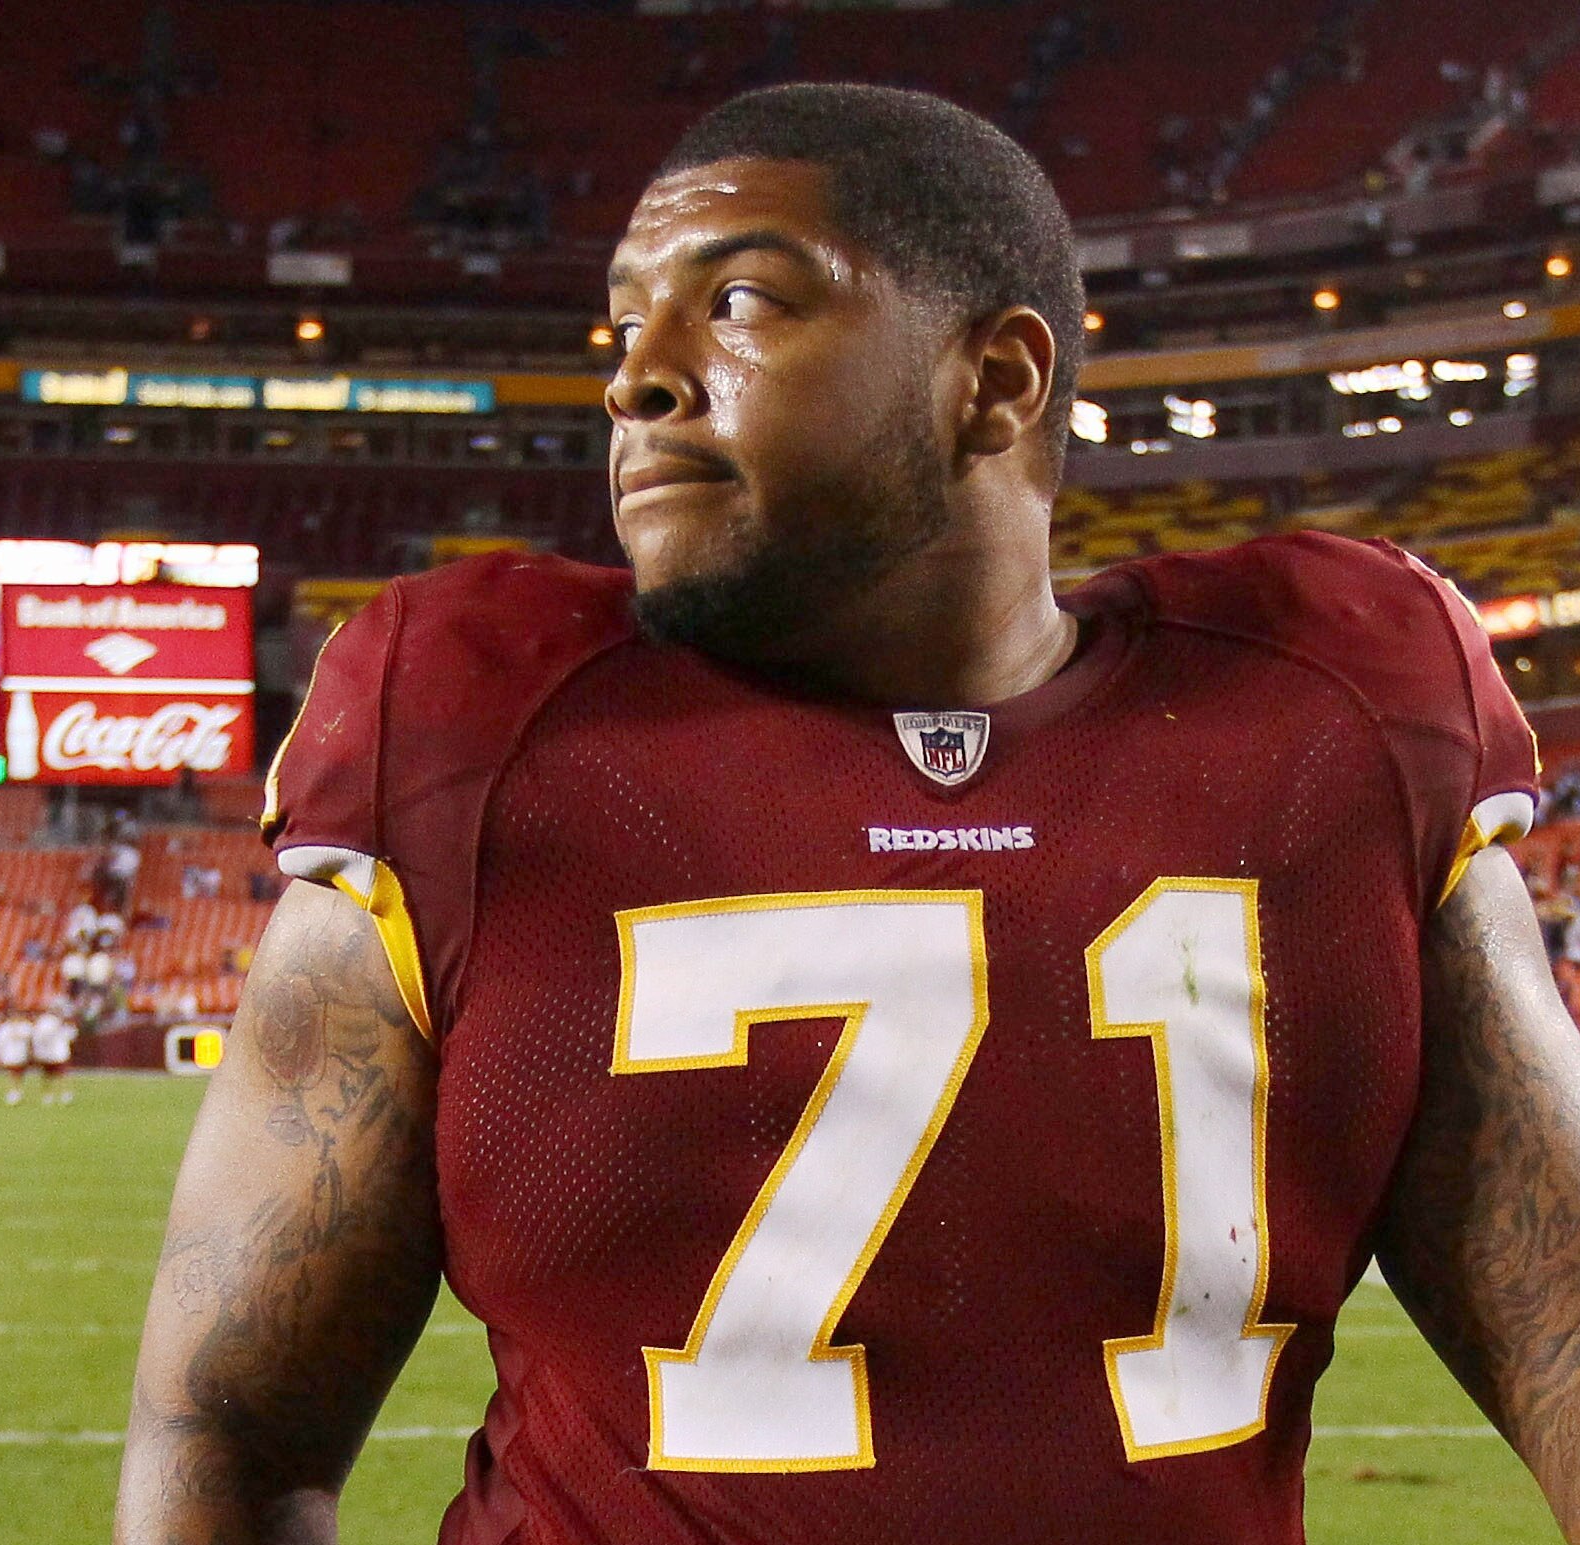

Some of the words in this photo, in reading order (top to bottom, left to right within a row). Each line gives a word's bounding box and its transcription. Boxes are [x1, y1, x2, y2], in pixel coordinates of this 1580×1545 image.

[925, 748, 965, 771] NFL
[868, 826, 1035, 853] REDSKINS
[611, 876, 1297, 1472] 71
